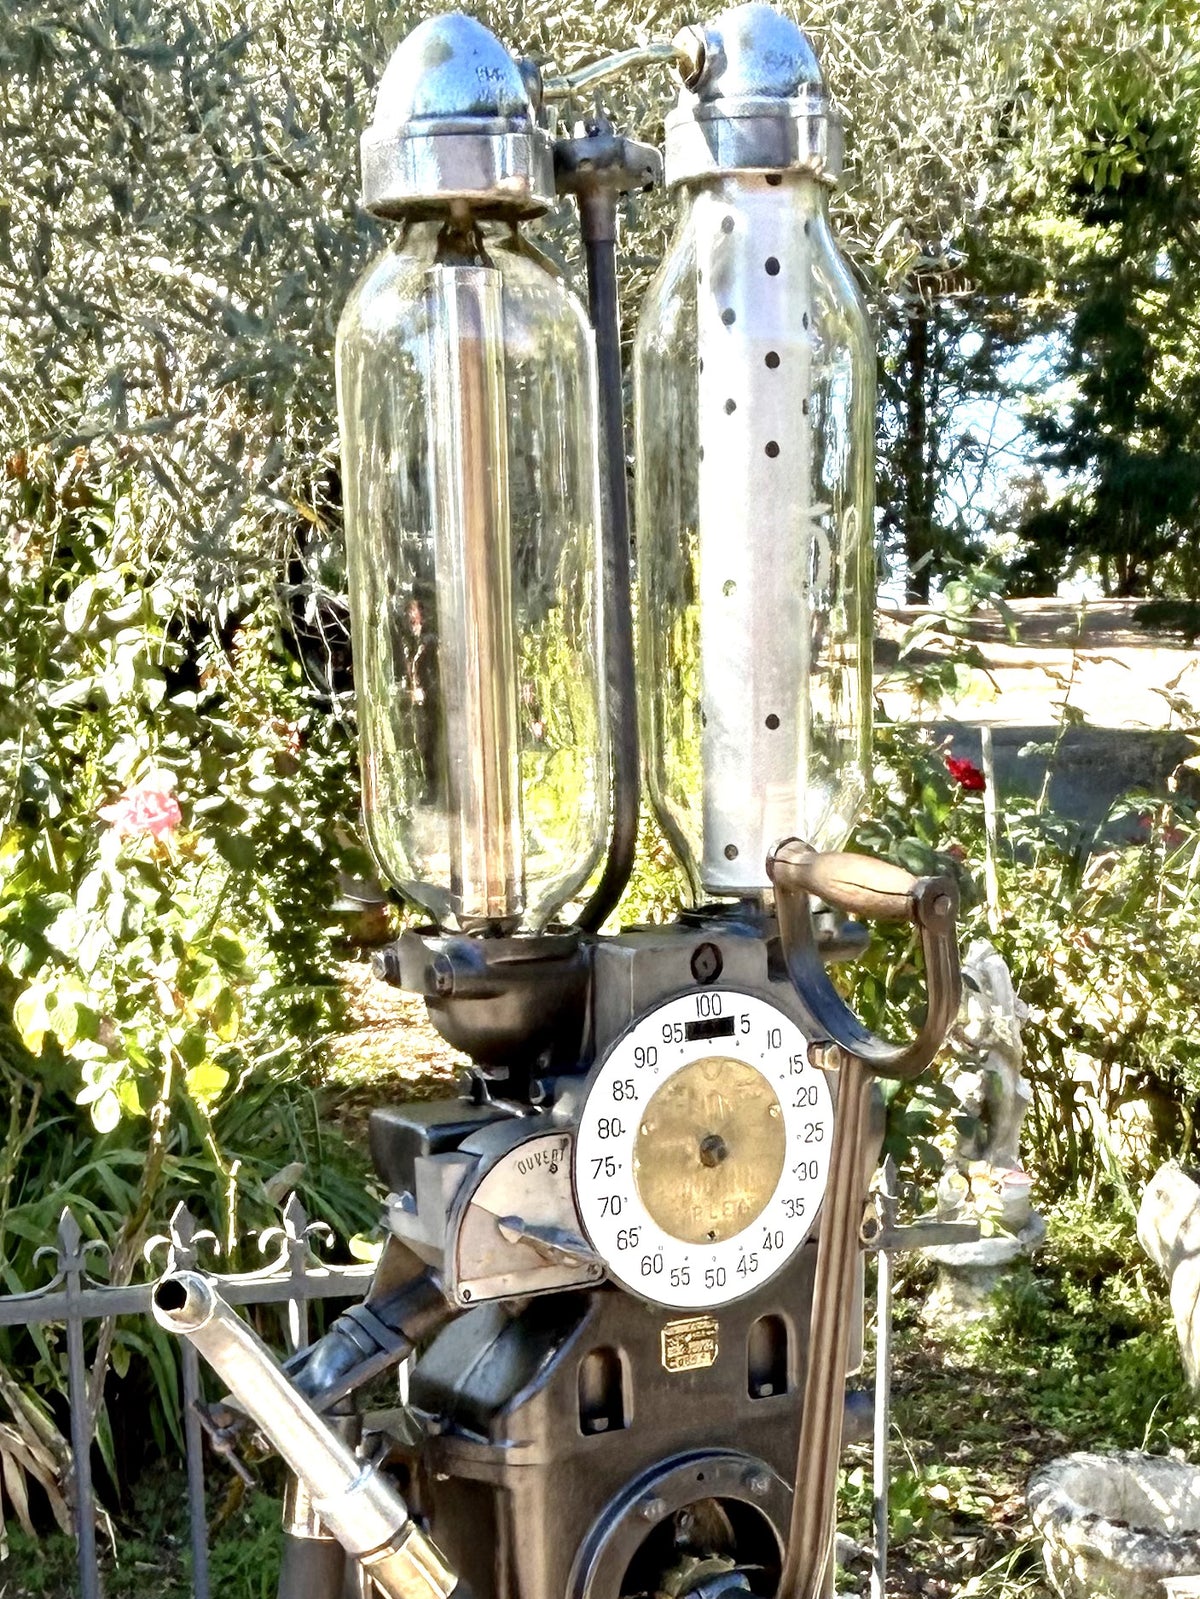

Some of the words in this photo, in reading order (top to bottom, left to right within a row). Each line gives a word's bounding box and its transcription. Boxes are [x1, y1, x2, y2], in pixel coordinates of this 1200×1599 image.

[695, 991, 725, 1016] 100
[663, 1023, 683, 1043] 95
[741, 1014, 750, 1034] 5
[766, 1029, 781, 1049] 10
[635, 1047, 657, 1068] 90
[788, 1055, 803, 1074] 15
[613, 1079, 634, 1101] 85
[797, 1086, 817, 1107] 20
[598, 1118, 621, 1139] 80
[805, 1122, 823, 1143] 25
[591, 1157, 615, 1179] 75
[798, 1161, 818, 1180] 30
[598, 1195, 621, 1217] 70
[785, 1198, 804, 1218] 35
[617, 1228, 638, 1250] 65
[763, 1231, 783, 1250] 40
[641, 1254, 663, 1276] 60
[736, 1253, 758, 1277] 45
[671, 1267, 690, 1286] 55
[706, 1268, 725, 1288] 50
